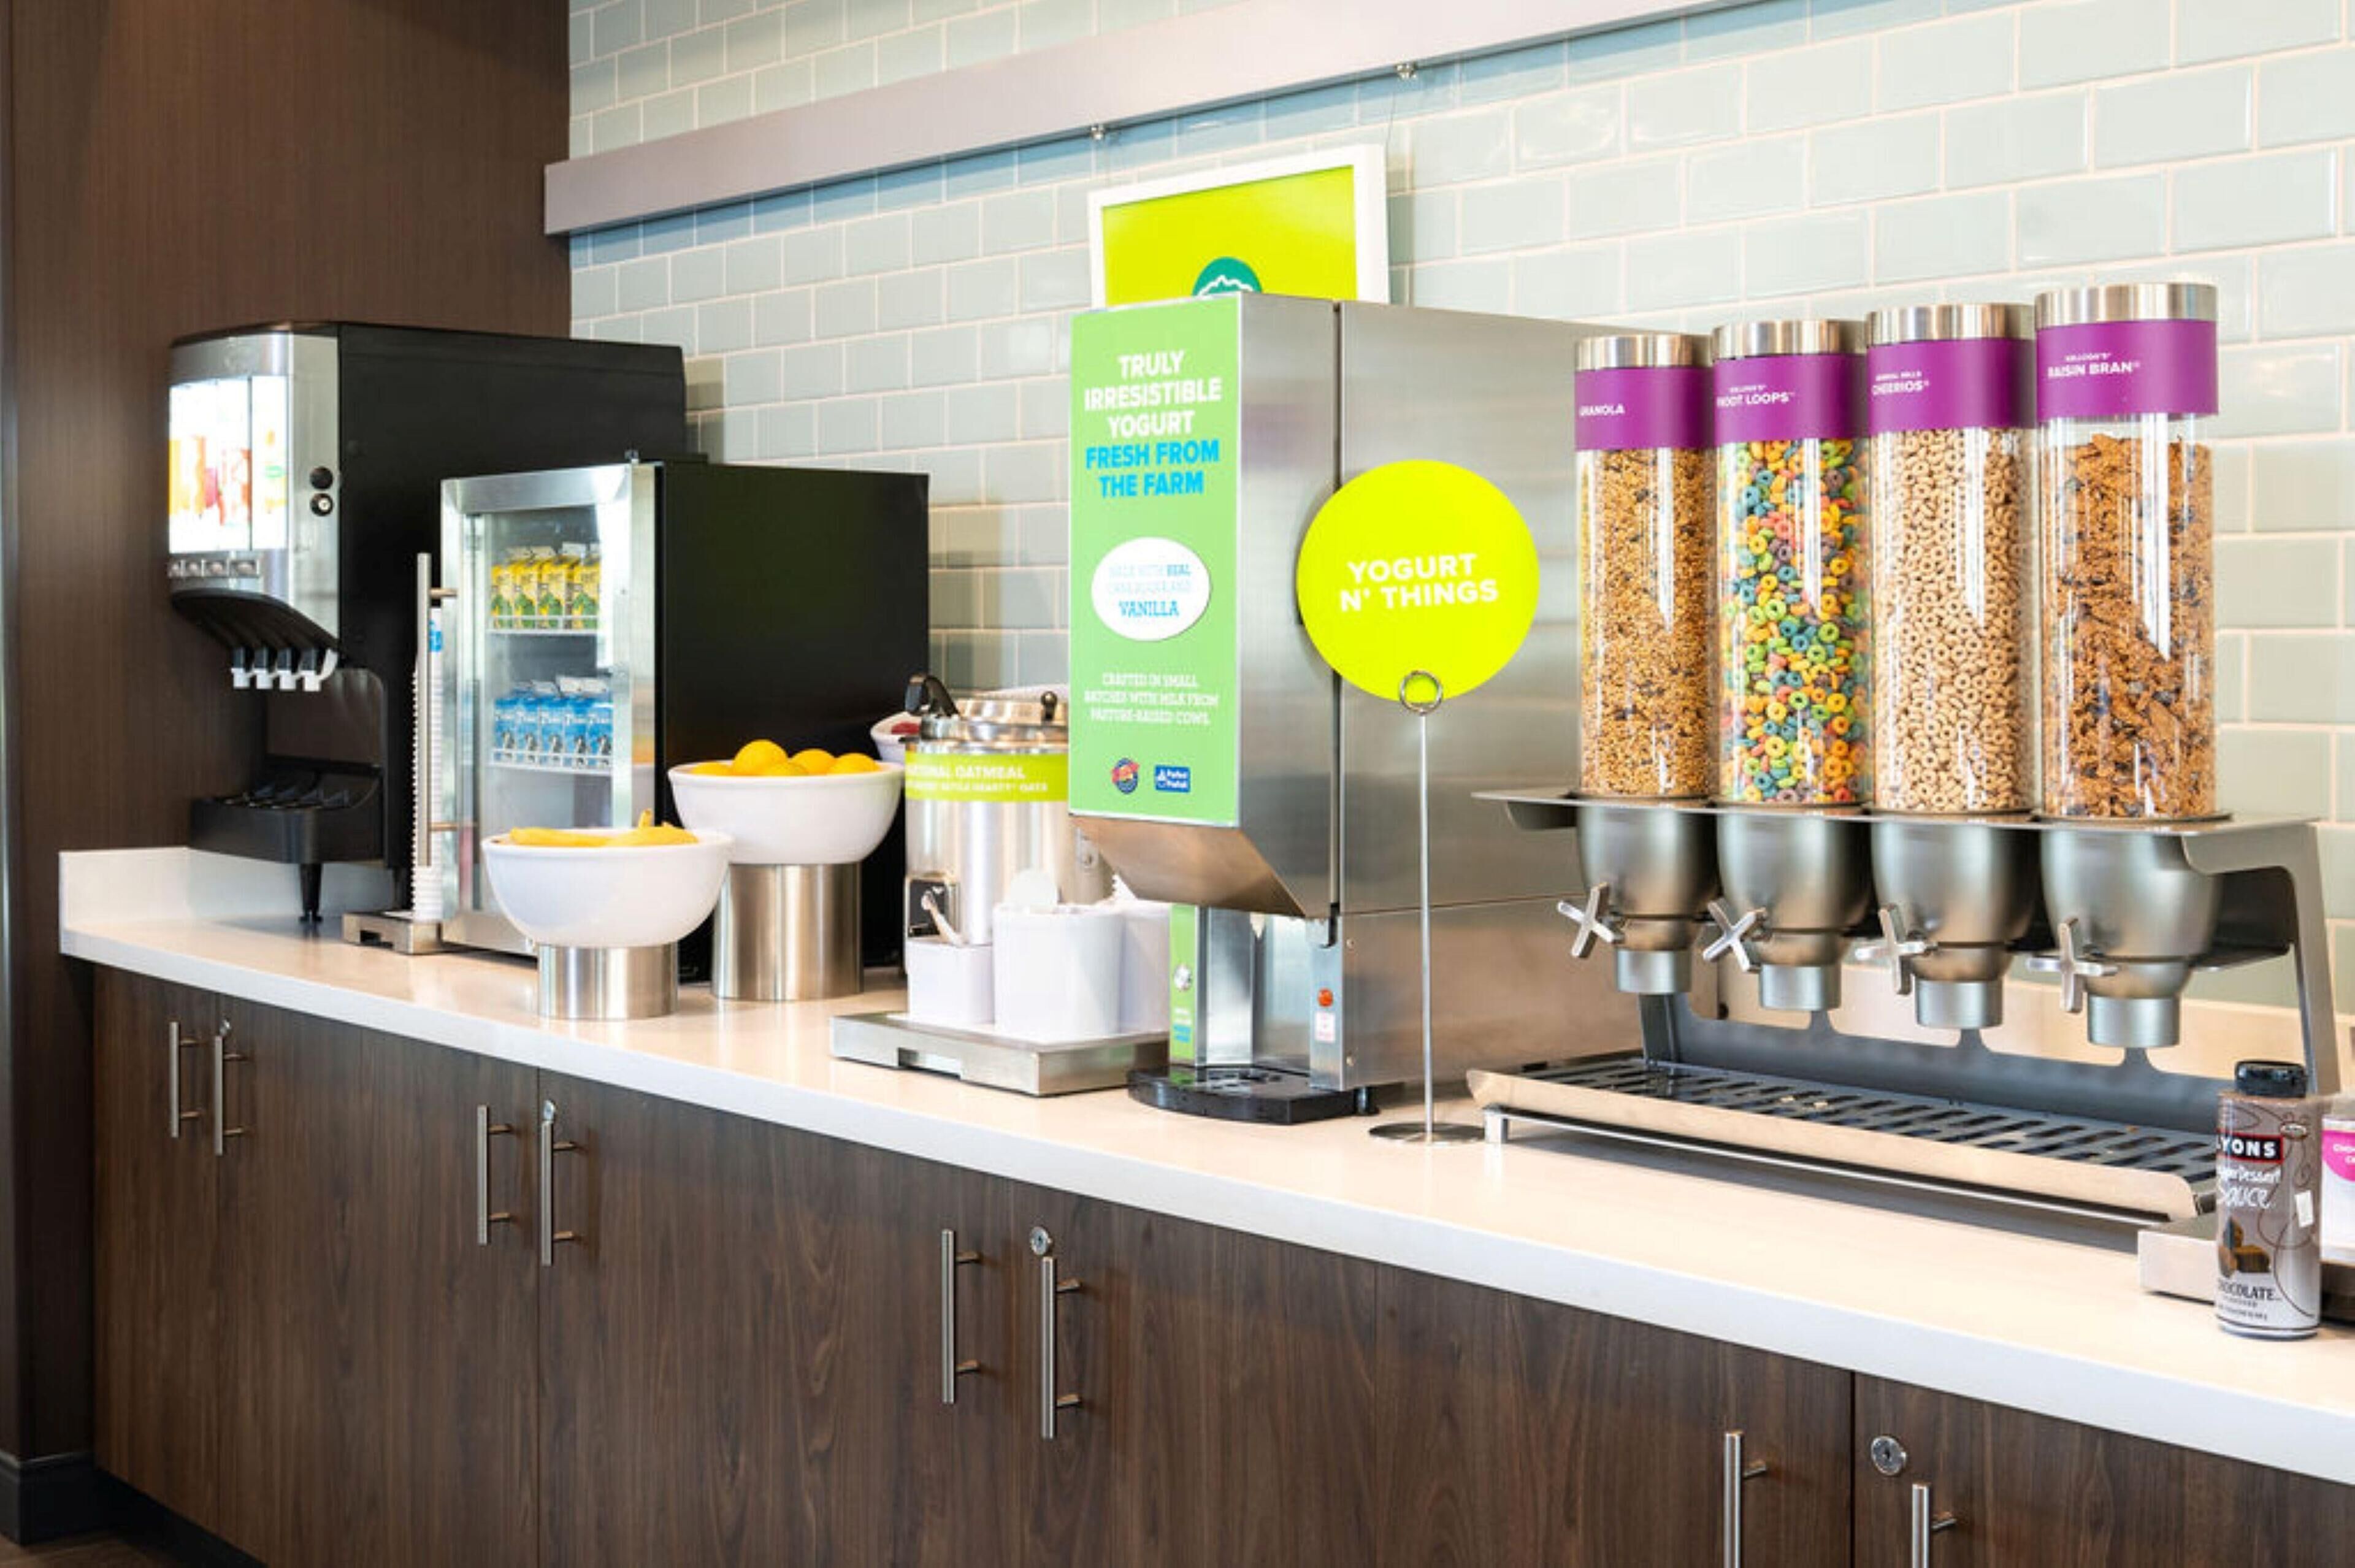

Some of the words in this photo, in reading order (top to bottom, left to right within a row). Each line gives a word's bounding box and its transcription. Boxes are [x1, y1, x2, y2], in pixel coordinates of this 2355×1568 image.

[1118, 350, 1184, 379] TRULY
[2089, 361, 2132, 375] BRAN
[1084, 377, 1222, 411] IRRESISTIBLE
[1747, 392, 1790, 405] LOOPS
[1108, 410, 1195, 439] YOGURT
[1086, 443, 1150, 470] FRESH
[1155, 438, 1220, 465] FROM
[1099, 474, 1137, 499] THE
[1143, 470, 1204, 496] FARM
[1348, 553, 1477, 584] YOGURT
[1118, 600, 1180, 618] VANILLA
[1339, 589, 1371, 612] N'
[1380, 579, 1498, 610] THINGS
[955, 766, 1026, 780] OATMEAL
